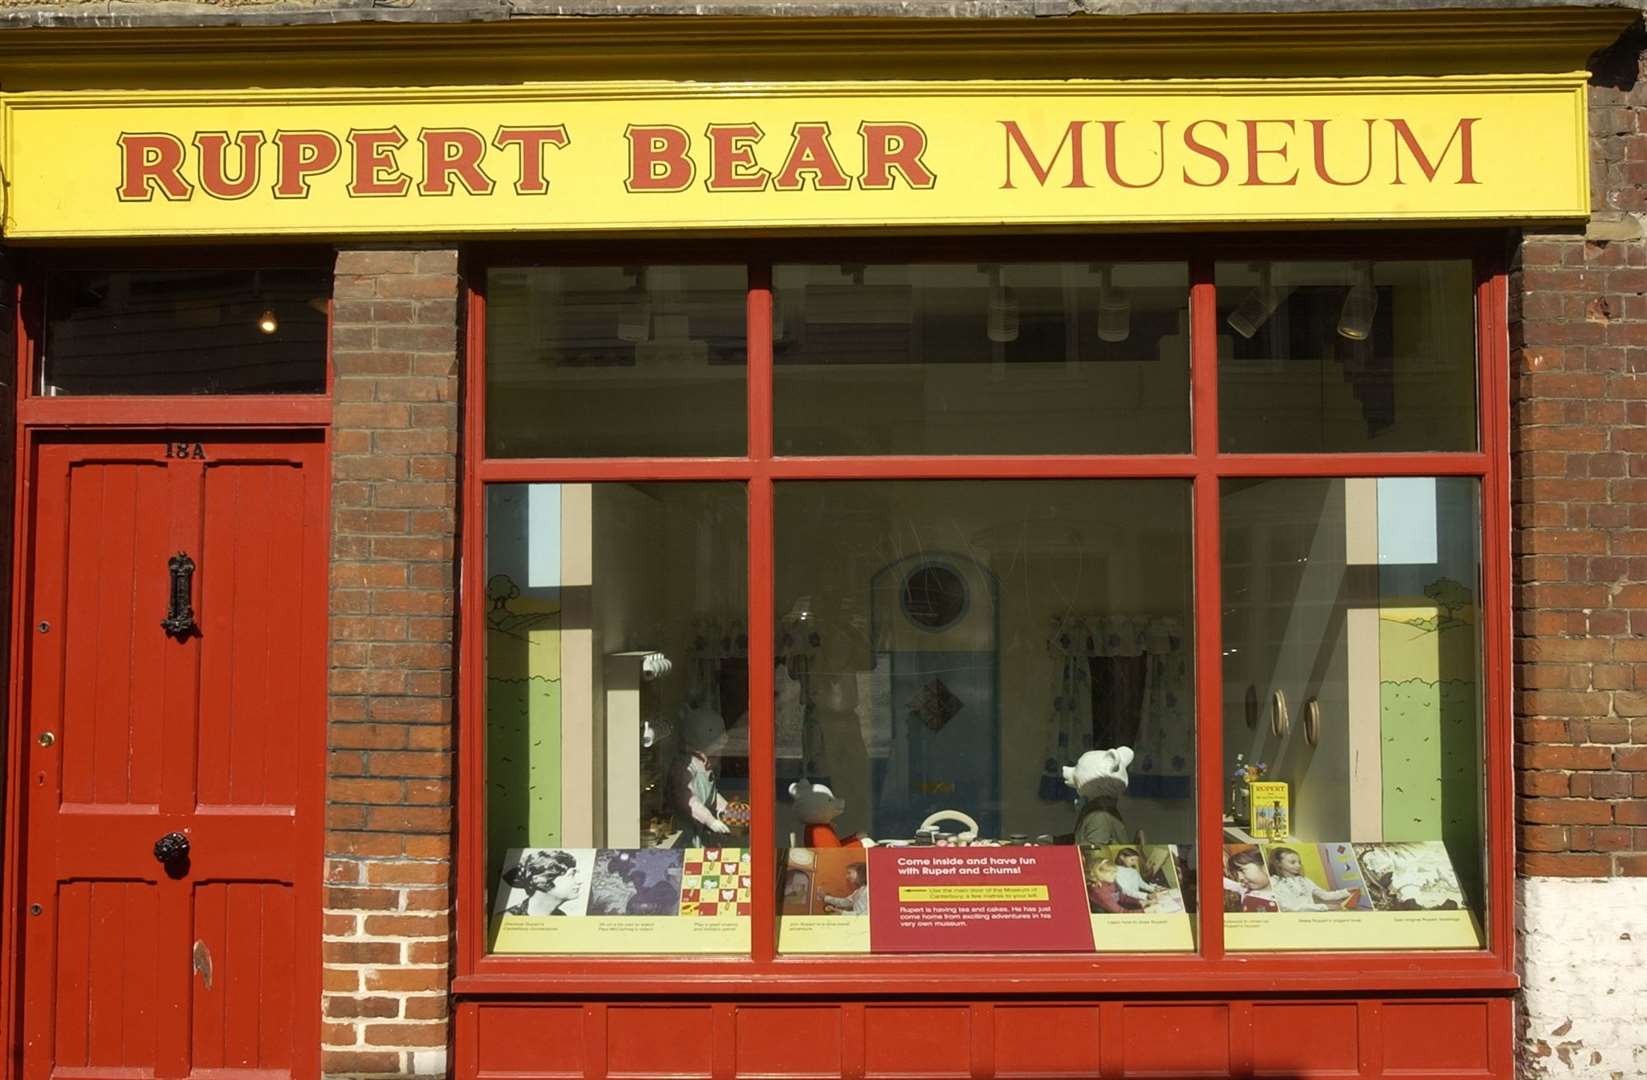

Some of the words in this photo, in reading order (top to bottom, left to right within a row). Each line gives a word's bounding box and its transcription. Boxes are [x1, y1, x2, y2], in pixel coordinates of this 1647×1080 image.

[116, 124, 571, 202] RUPERT
[624, 120, 937, 194] BEAR
[995, 117, 1484, 190] MUSEUM
[165, 442, 206, 460] 18A
[897, 858, 930, 866] Come
[990, 857, 1017, 865] have
[922, 867, 957, 876] Rupert
[982, 866, 1022, 874] chums!
